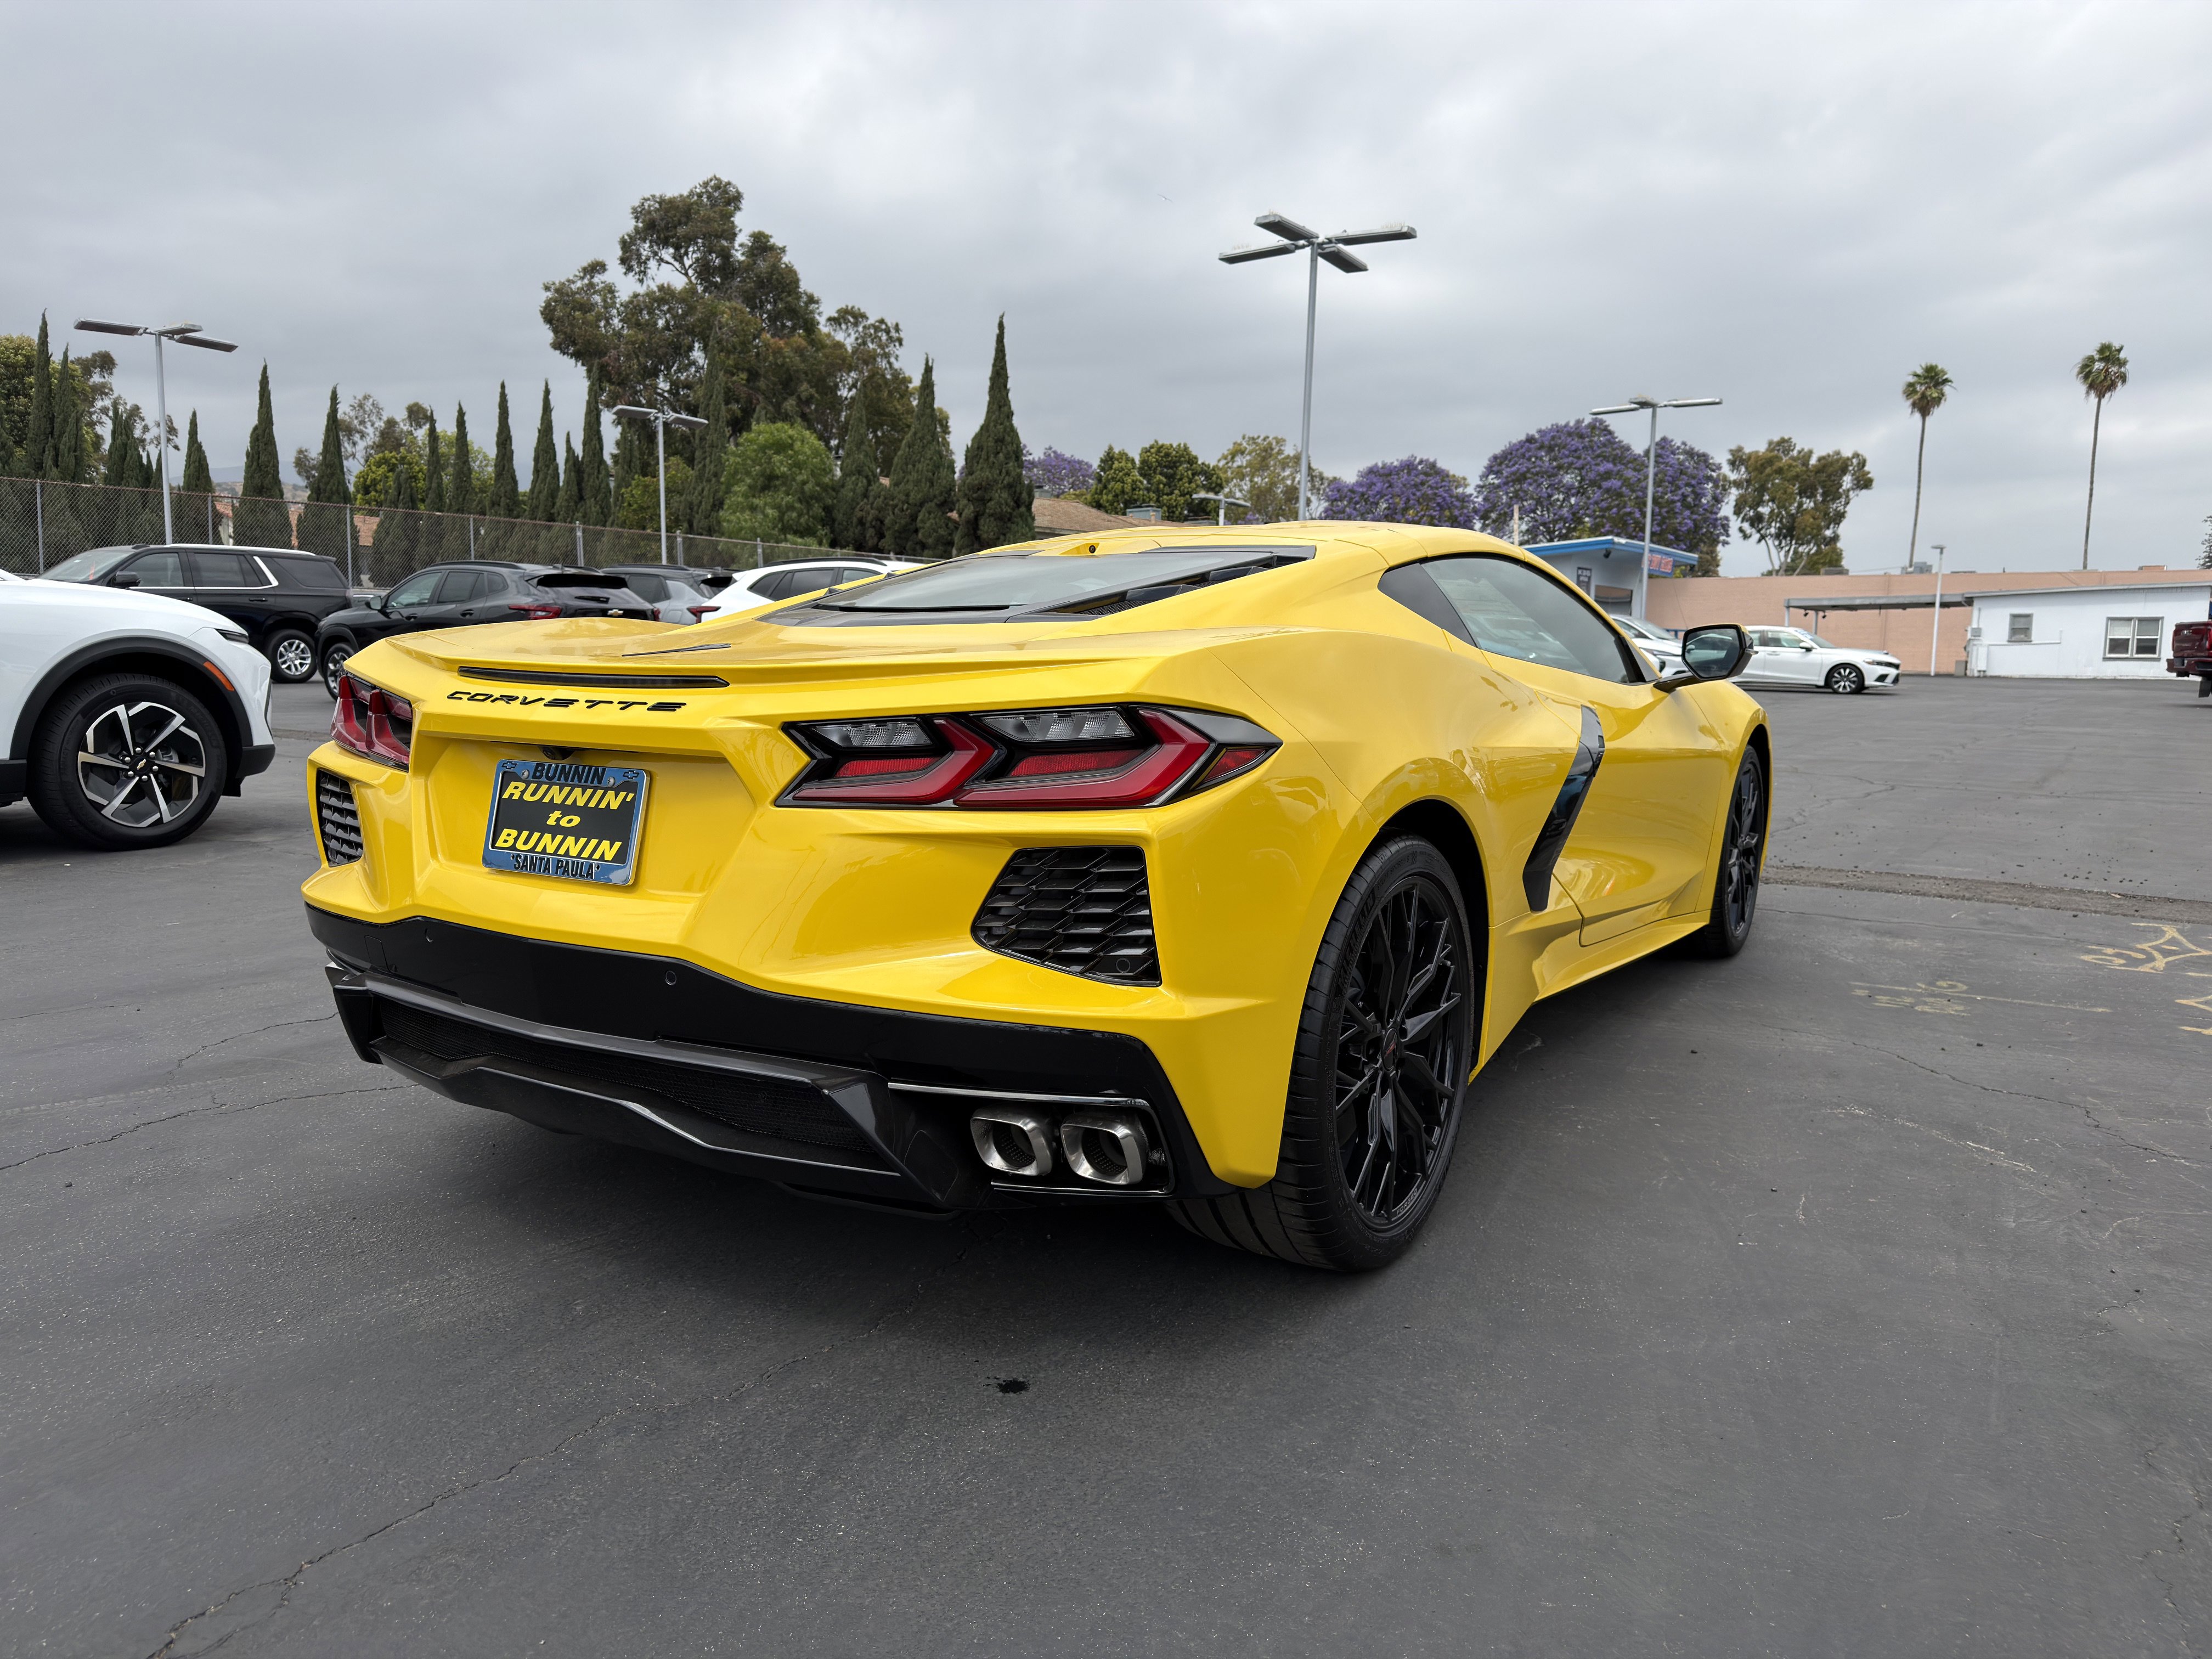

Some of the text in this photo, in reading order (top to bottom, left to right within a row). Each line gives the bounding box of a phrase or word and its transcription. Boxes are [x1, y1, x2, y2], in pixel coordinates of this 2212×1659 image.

[447, 691, 687, 712] CORVETTE
[531, 763, 607, 785] BUNNIN
[502, 781, 635, 810] RUNNIN'
[546, 810, 580, 827] to
[495, 828, 622, 861] BUNNIN
[514, 854, 595, 879] SANTA PAULA
